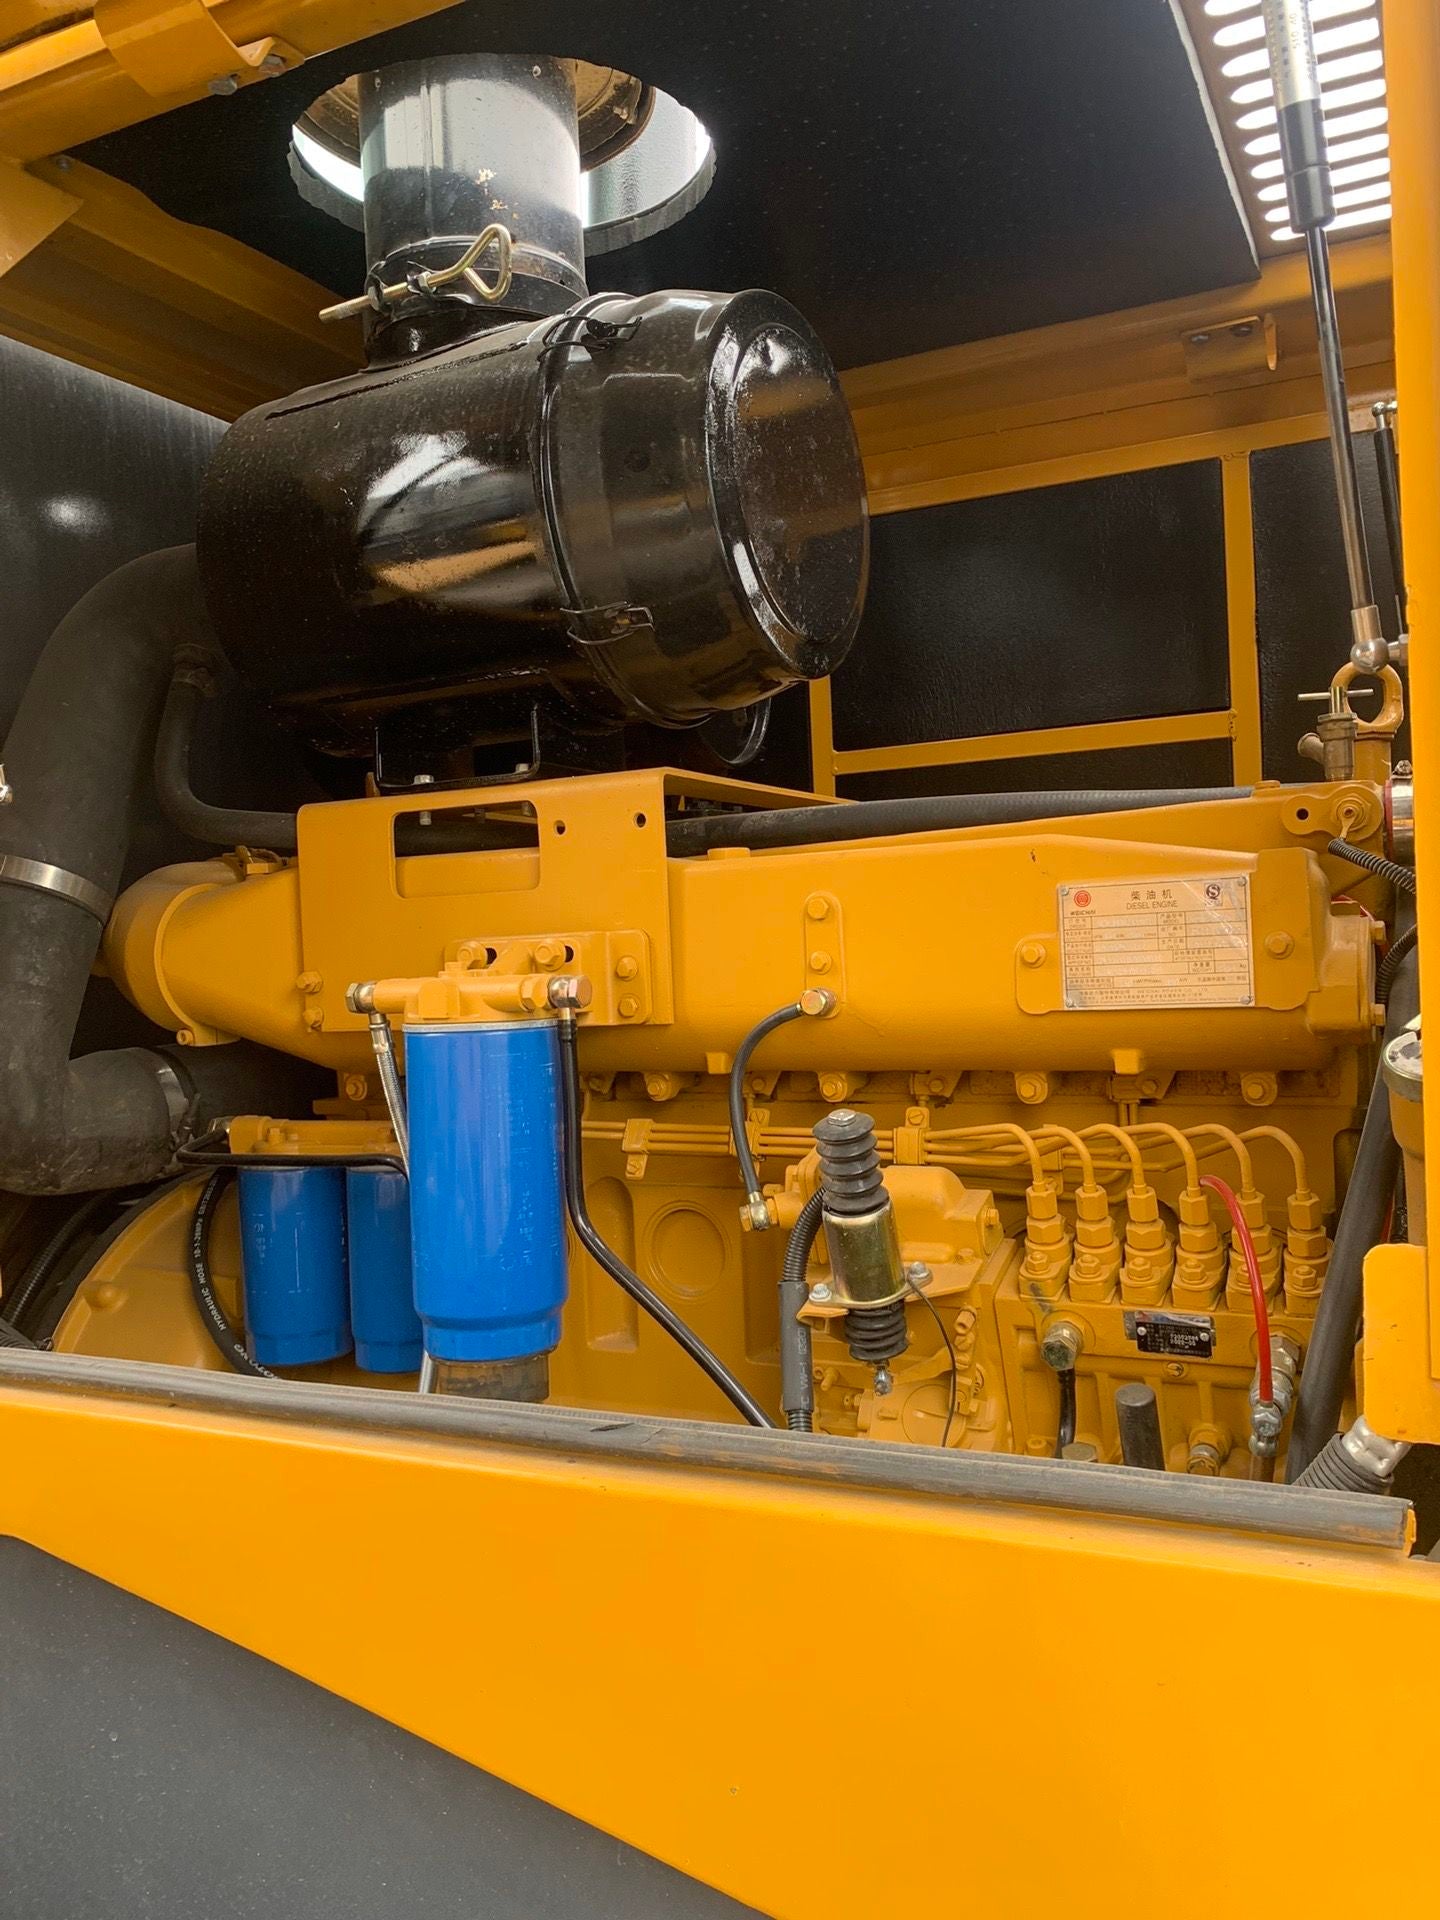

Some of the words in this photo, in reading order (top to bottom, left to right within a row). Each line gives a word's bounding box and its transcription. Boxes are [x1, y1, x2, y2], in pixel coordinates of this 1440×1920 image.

[1131, 889, 1173, 900] 柴油机
[1126, 902, 1150, 910] DIESEL
[1152, 900, 1178, 909] ENGINE
[201, 1287, 227, 1331] HYDRAULIC
